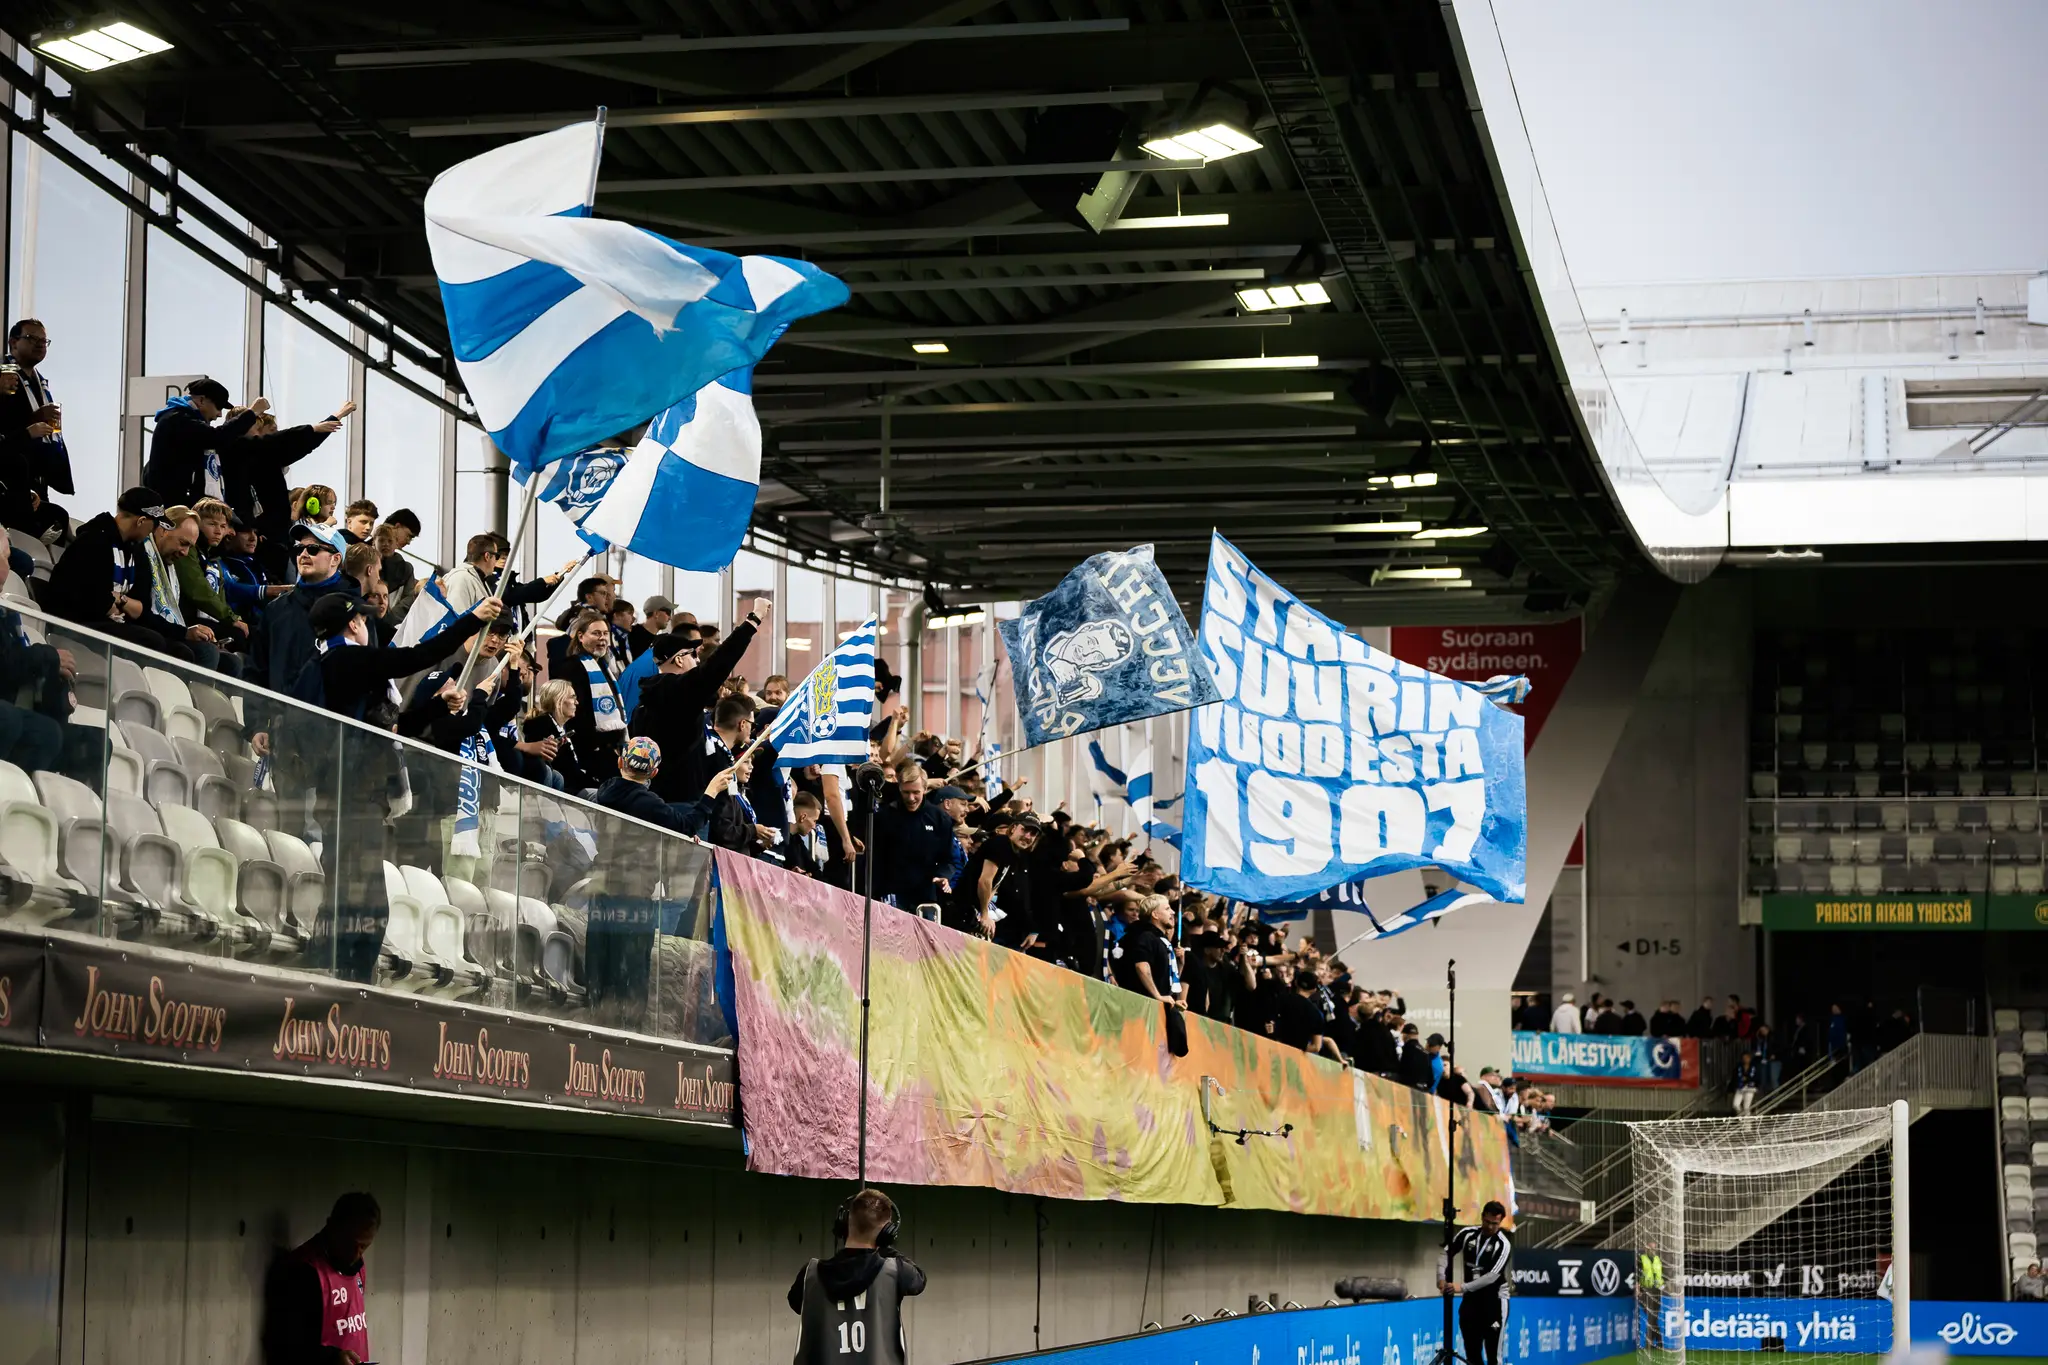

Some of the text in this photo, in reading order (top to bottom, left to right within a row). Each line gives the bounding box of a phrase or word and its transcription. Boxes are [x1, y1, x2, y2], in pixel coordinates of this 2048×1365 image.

[165, 385, 189, 405] D
[1442, 629, 1534, 647] Suoraan
[1201, 611, 1481, 736] SUURIN
[1427, 652, 1548, 673] sydämeen.
[1198, 703, 1485, 784] VUODESTA
[1196, 757, 1486, 876] 1907
[1816, 902, 1872, 923] PARASTA
[1876, 902, 1913, 923] AIKAA
[1636, 938, 1681, 956] D1-5
[1548, 1036, 1632, 1068] LÄHESTYY!
[1801, 1265, 1824, 1295] IS
[332, 1287, 347, 1305] 20
[838, 1321, 865, 1353] 10
[1664, 1308, 1787, 1339] Pidetään
[1796, 1311, 1856, 1347] yhtä
[1937, 1312, 2018, 1345] elisa
